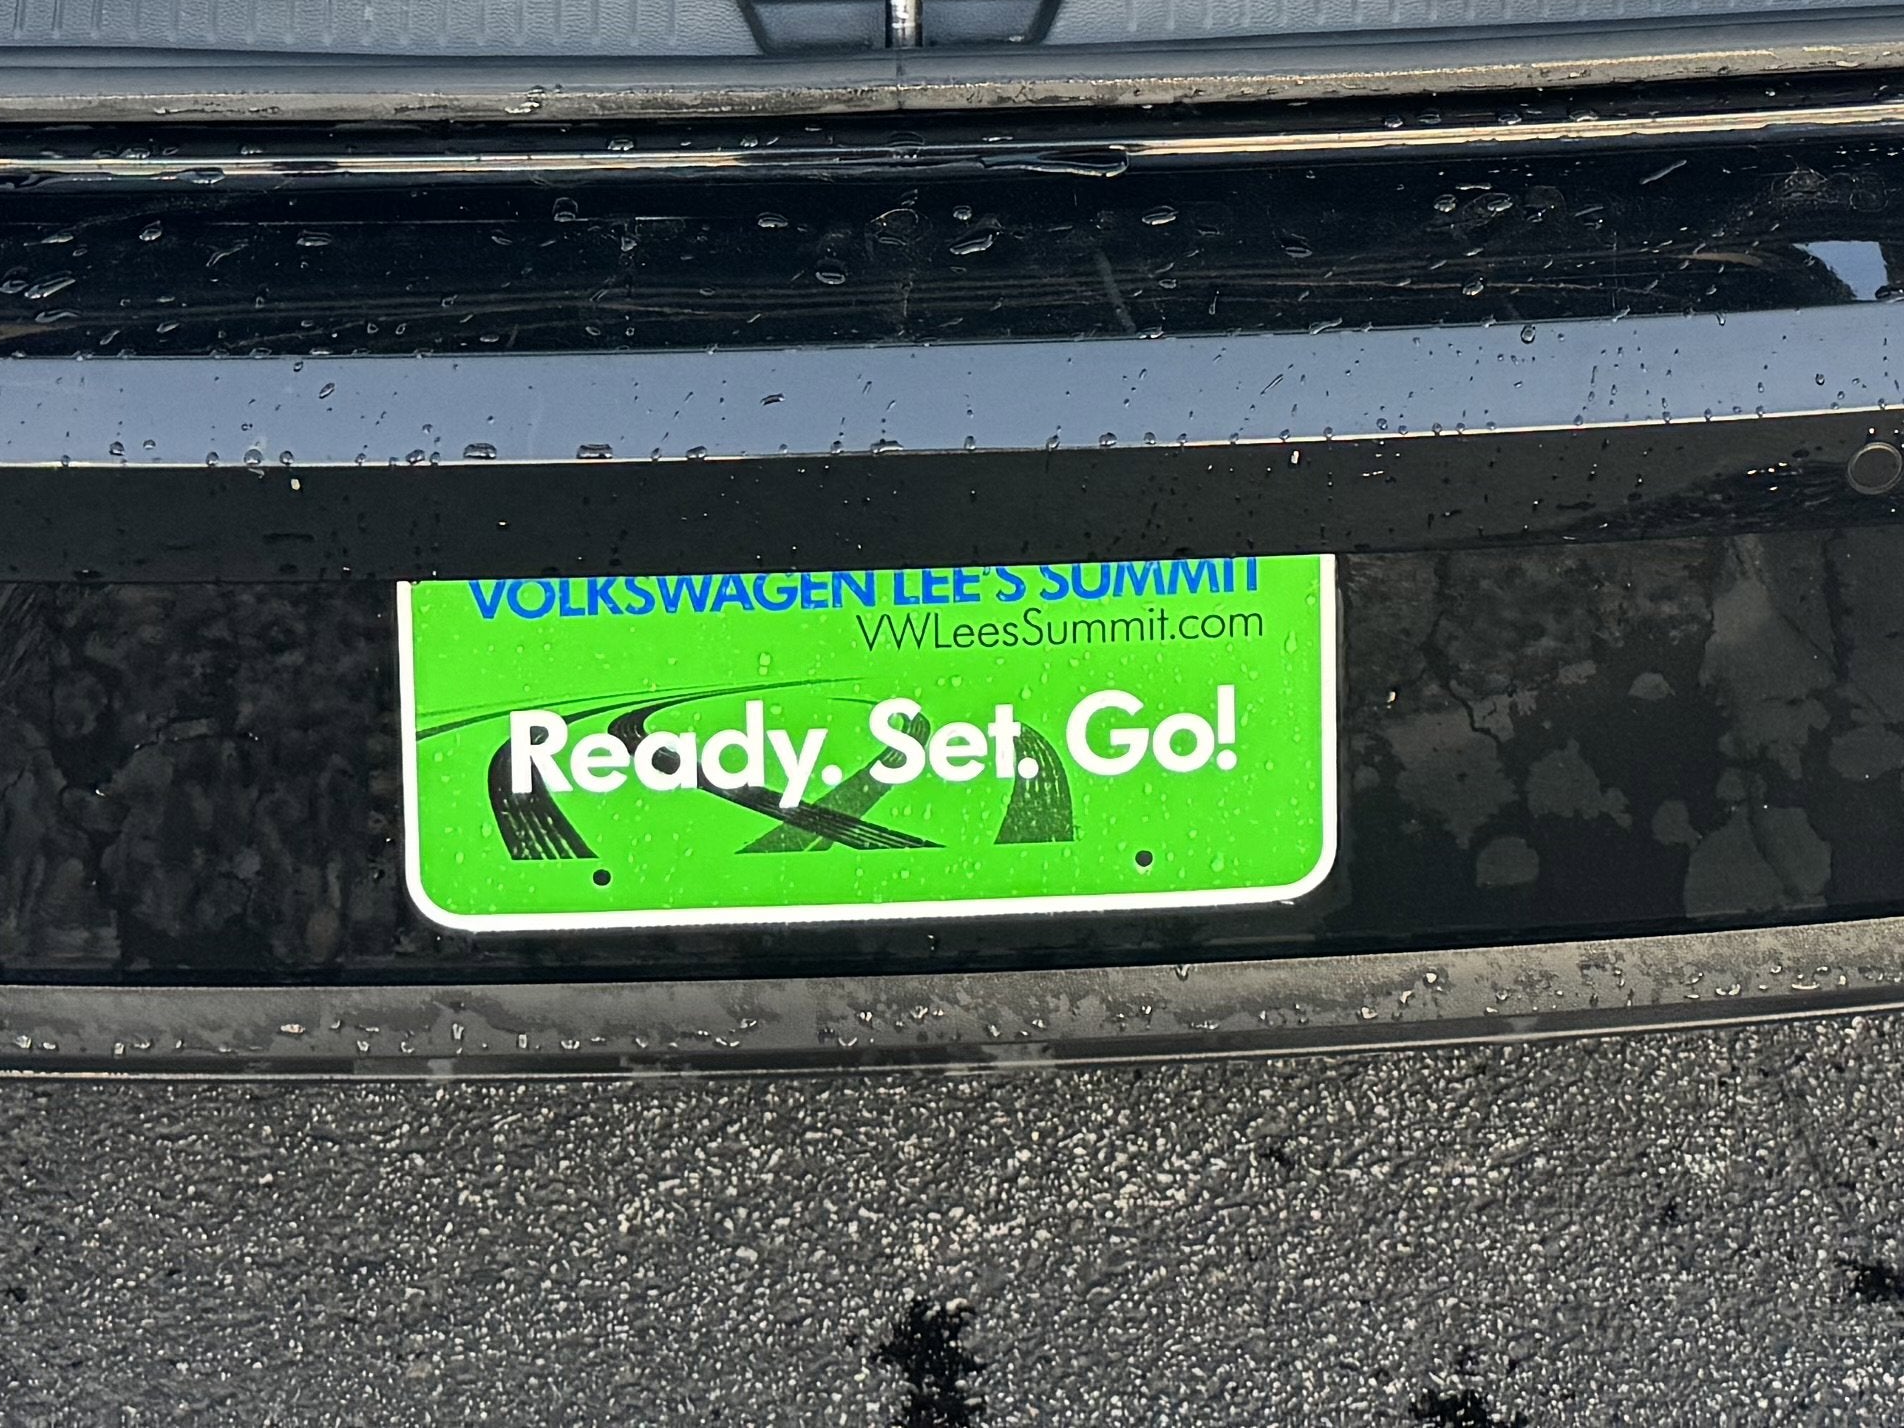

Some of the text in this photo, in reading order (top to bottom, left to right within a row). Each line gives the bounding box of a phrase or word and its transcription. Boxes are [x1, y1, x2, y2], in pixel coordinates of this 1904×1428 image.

[468, 570, 877, 620] VOLKSWAGEN
[854, 607, 1265, 652] VWLeesSummit.com
[509, 684, 1238, 810] Ready. Set. Go!
